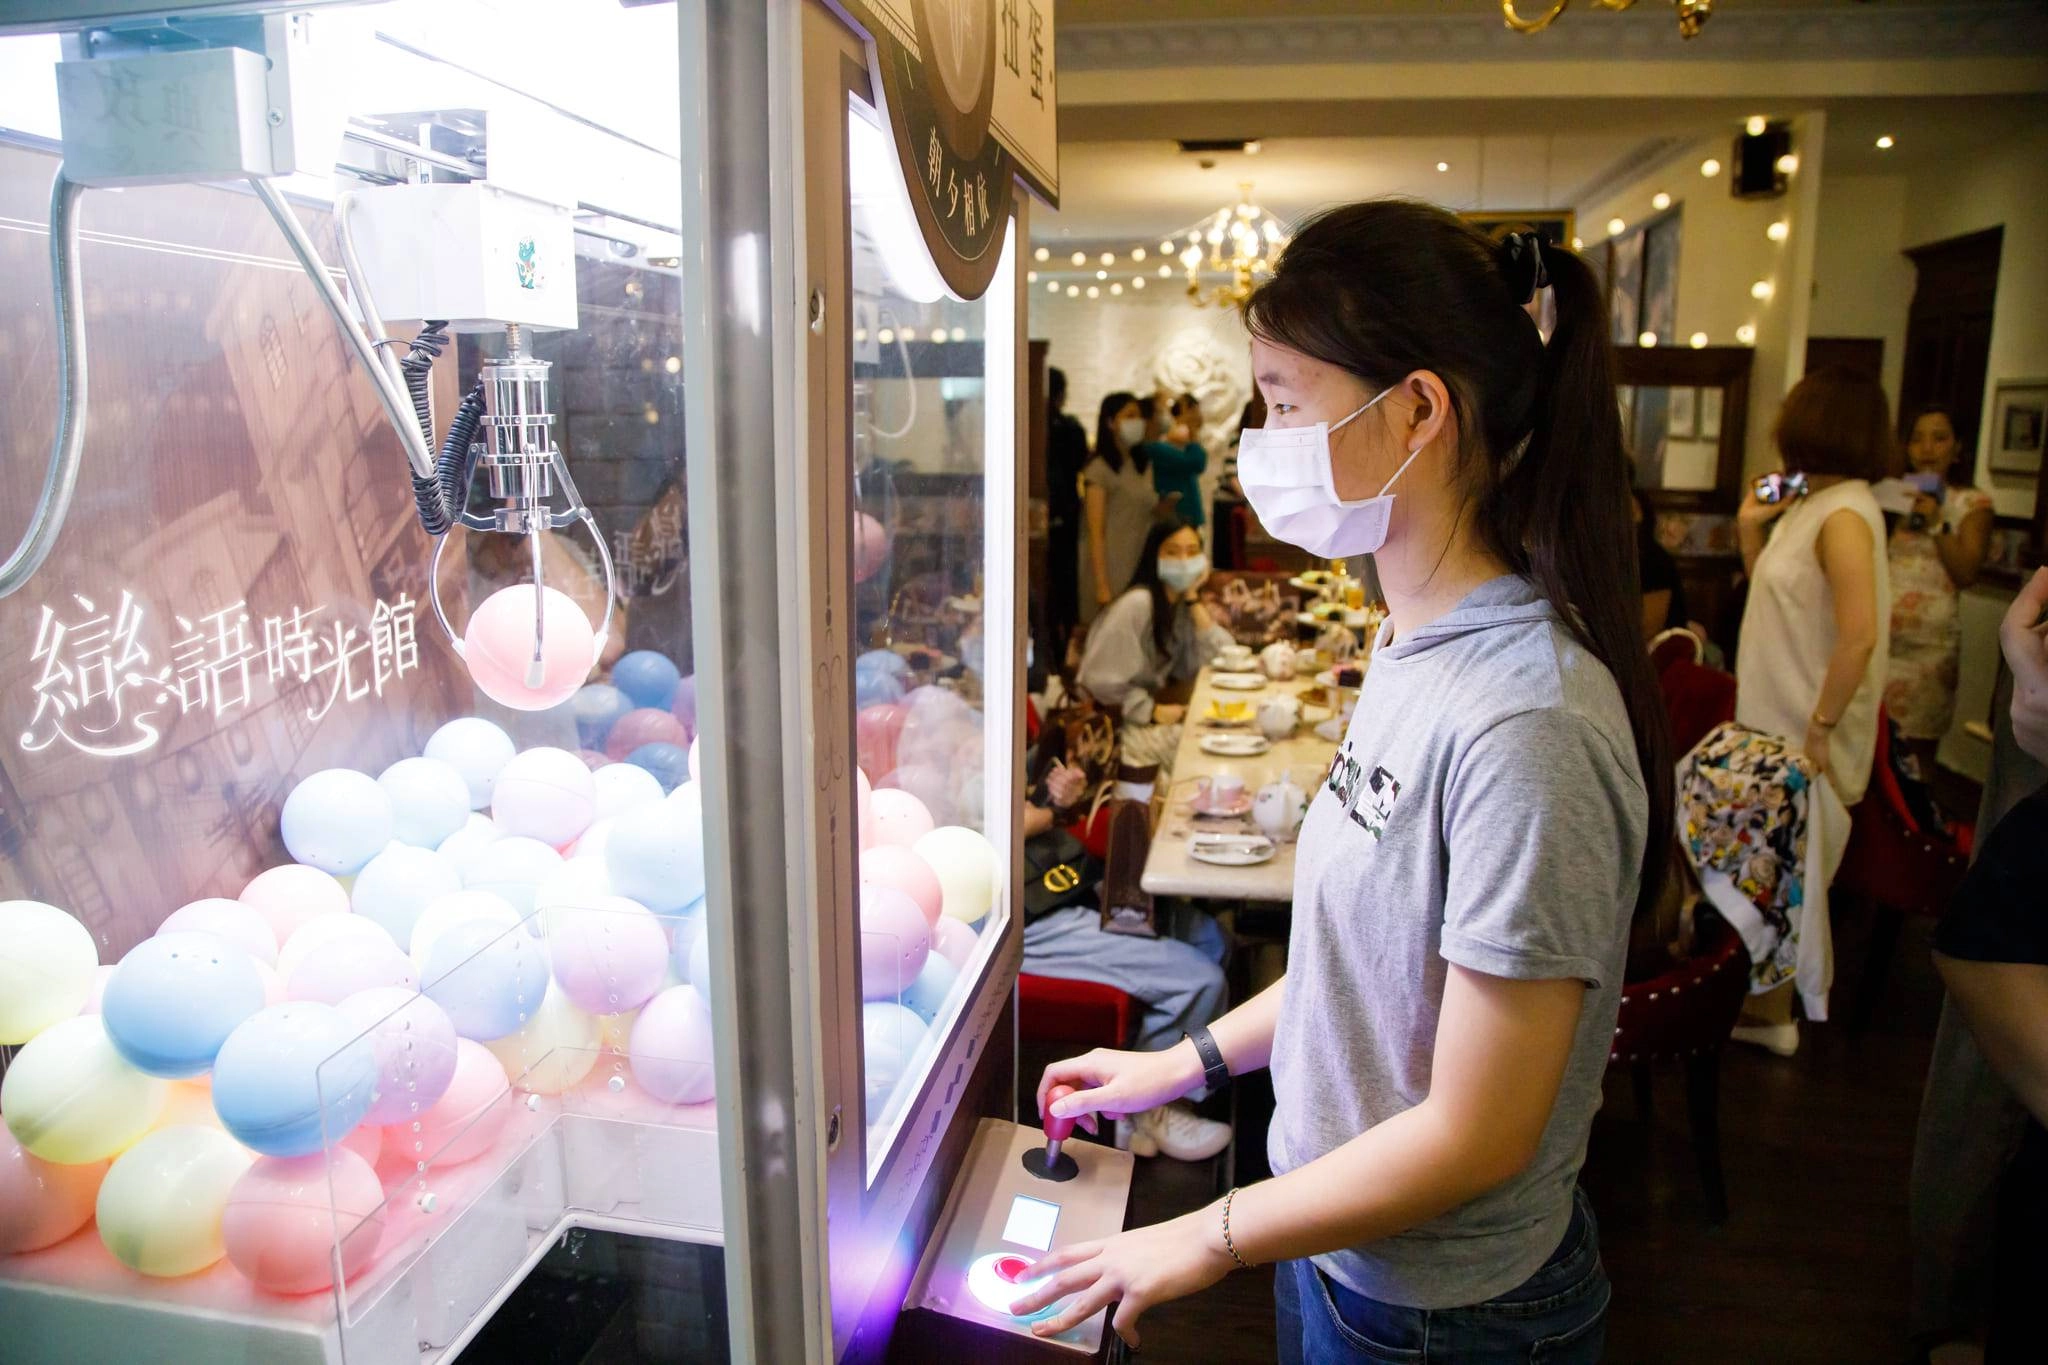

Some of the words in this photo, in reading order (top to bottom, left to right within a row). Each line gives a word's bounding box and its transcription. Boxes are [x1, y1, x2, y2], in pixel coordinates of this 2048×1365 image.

[19, 588, 420, 758] 戀語時光館
